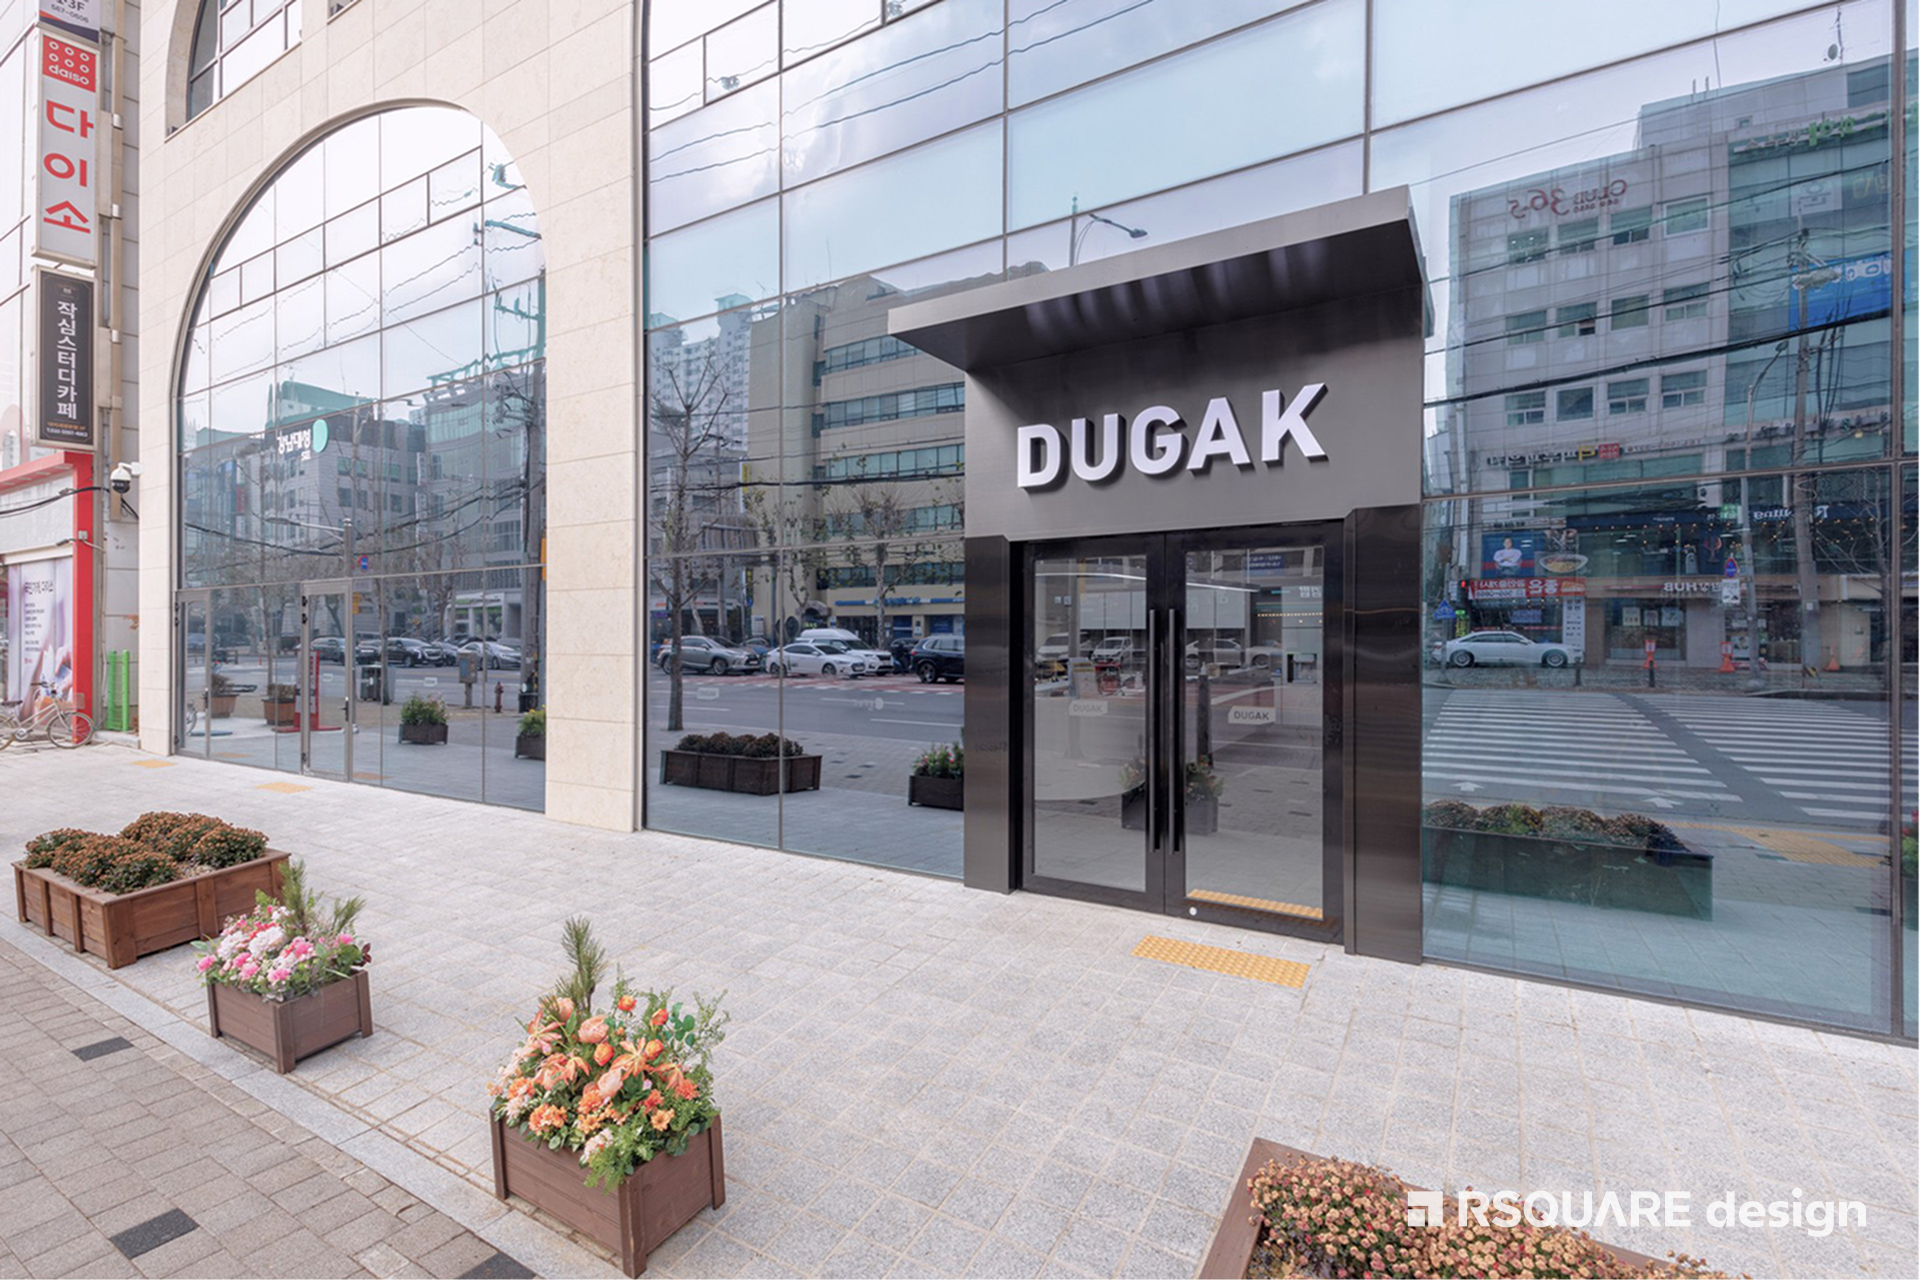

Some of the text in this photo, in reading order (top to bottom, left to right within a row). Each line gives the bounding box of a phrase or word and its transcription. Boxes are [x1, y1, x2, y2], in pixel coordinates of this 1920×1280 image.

[48, 64, 90, 86] daiso
[43, 99, 95, 235] 다이소
[57, 300, 78, 420] 작심스터디카페
[1018, 382, 1328, 490] DUGAK
[1073, 704, 1103, 712] DUGAK
[1234, 710, 1270, 720] DUGAK
